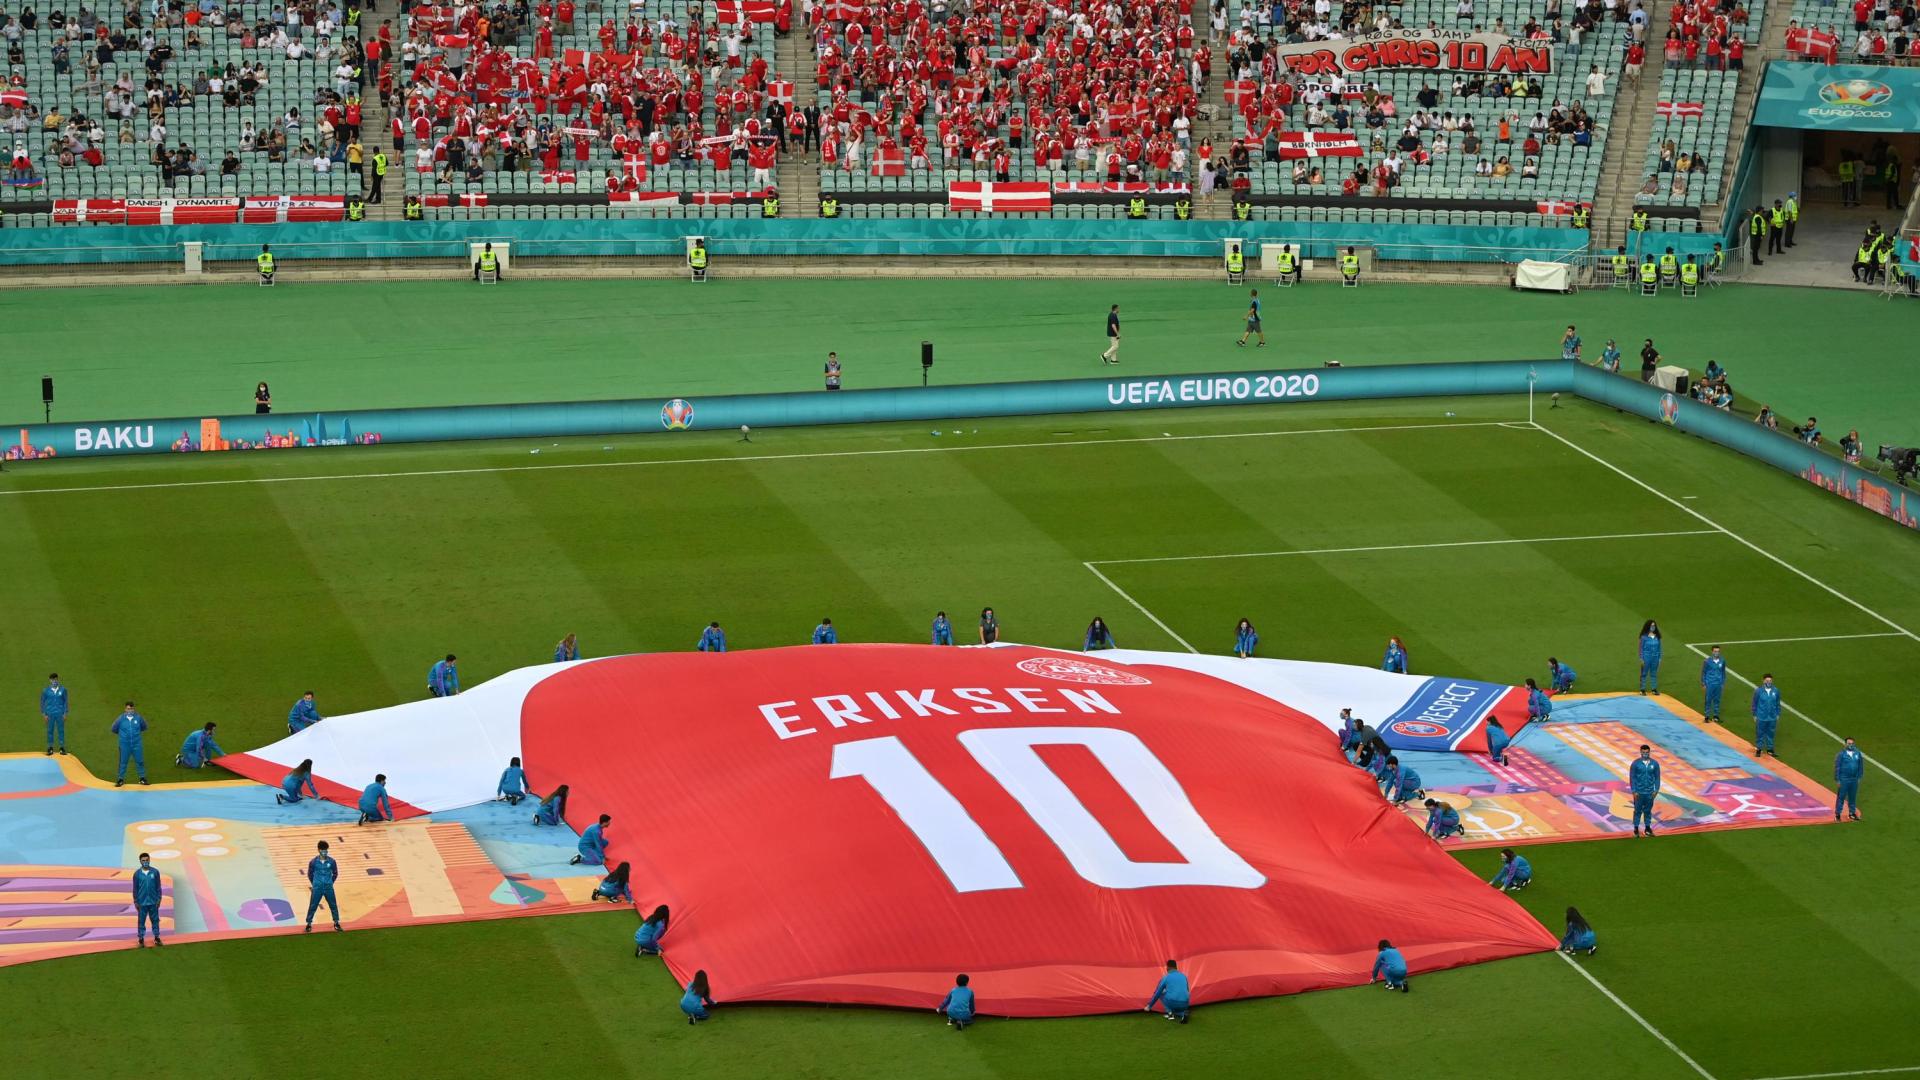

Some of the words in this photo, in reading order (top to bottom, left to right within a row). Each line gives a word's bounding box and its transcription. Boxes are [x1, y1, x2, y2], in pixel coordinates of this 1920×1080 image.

[1402, 29, 1422, 38] OG
[1432, 28, 1472, 40] DAMP
[1283, 49, 1343, 78] FOR
[1342, 38, 1441, 72] CHRIS
[1442, 39, 1488, 71] 10
[1488, 44, 1551, 73] AN
[1107, 381, 1175, 404] UEFA
[1180, 378, 1249, 401] EURO
[1254, 374, 1319, 398] 2020
[75, 426, 154, 450] BAKU
[758, 687, 1122, 740] ERIKSEN
[1415, 682, 1480, 725] RESPECT
[829, 726, 1268, 894] 10
